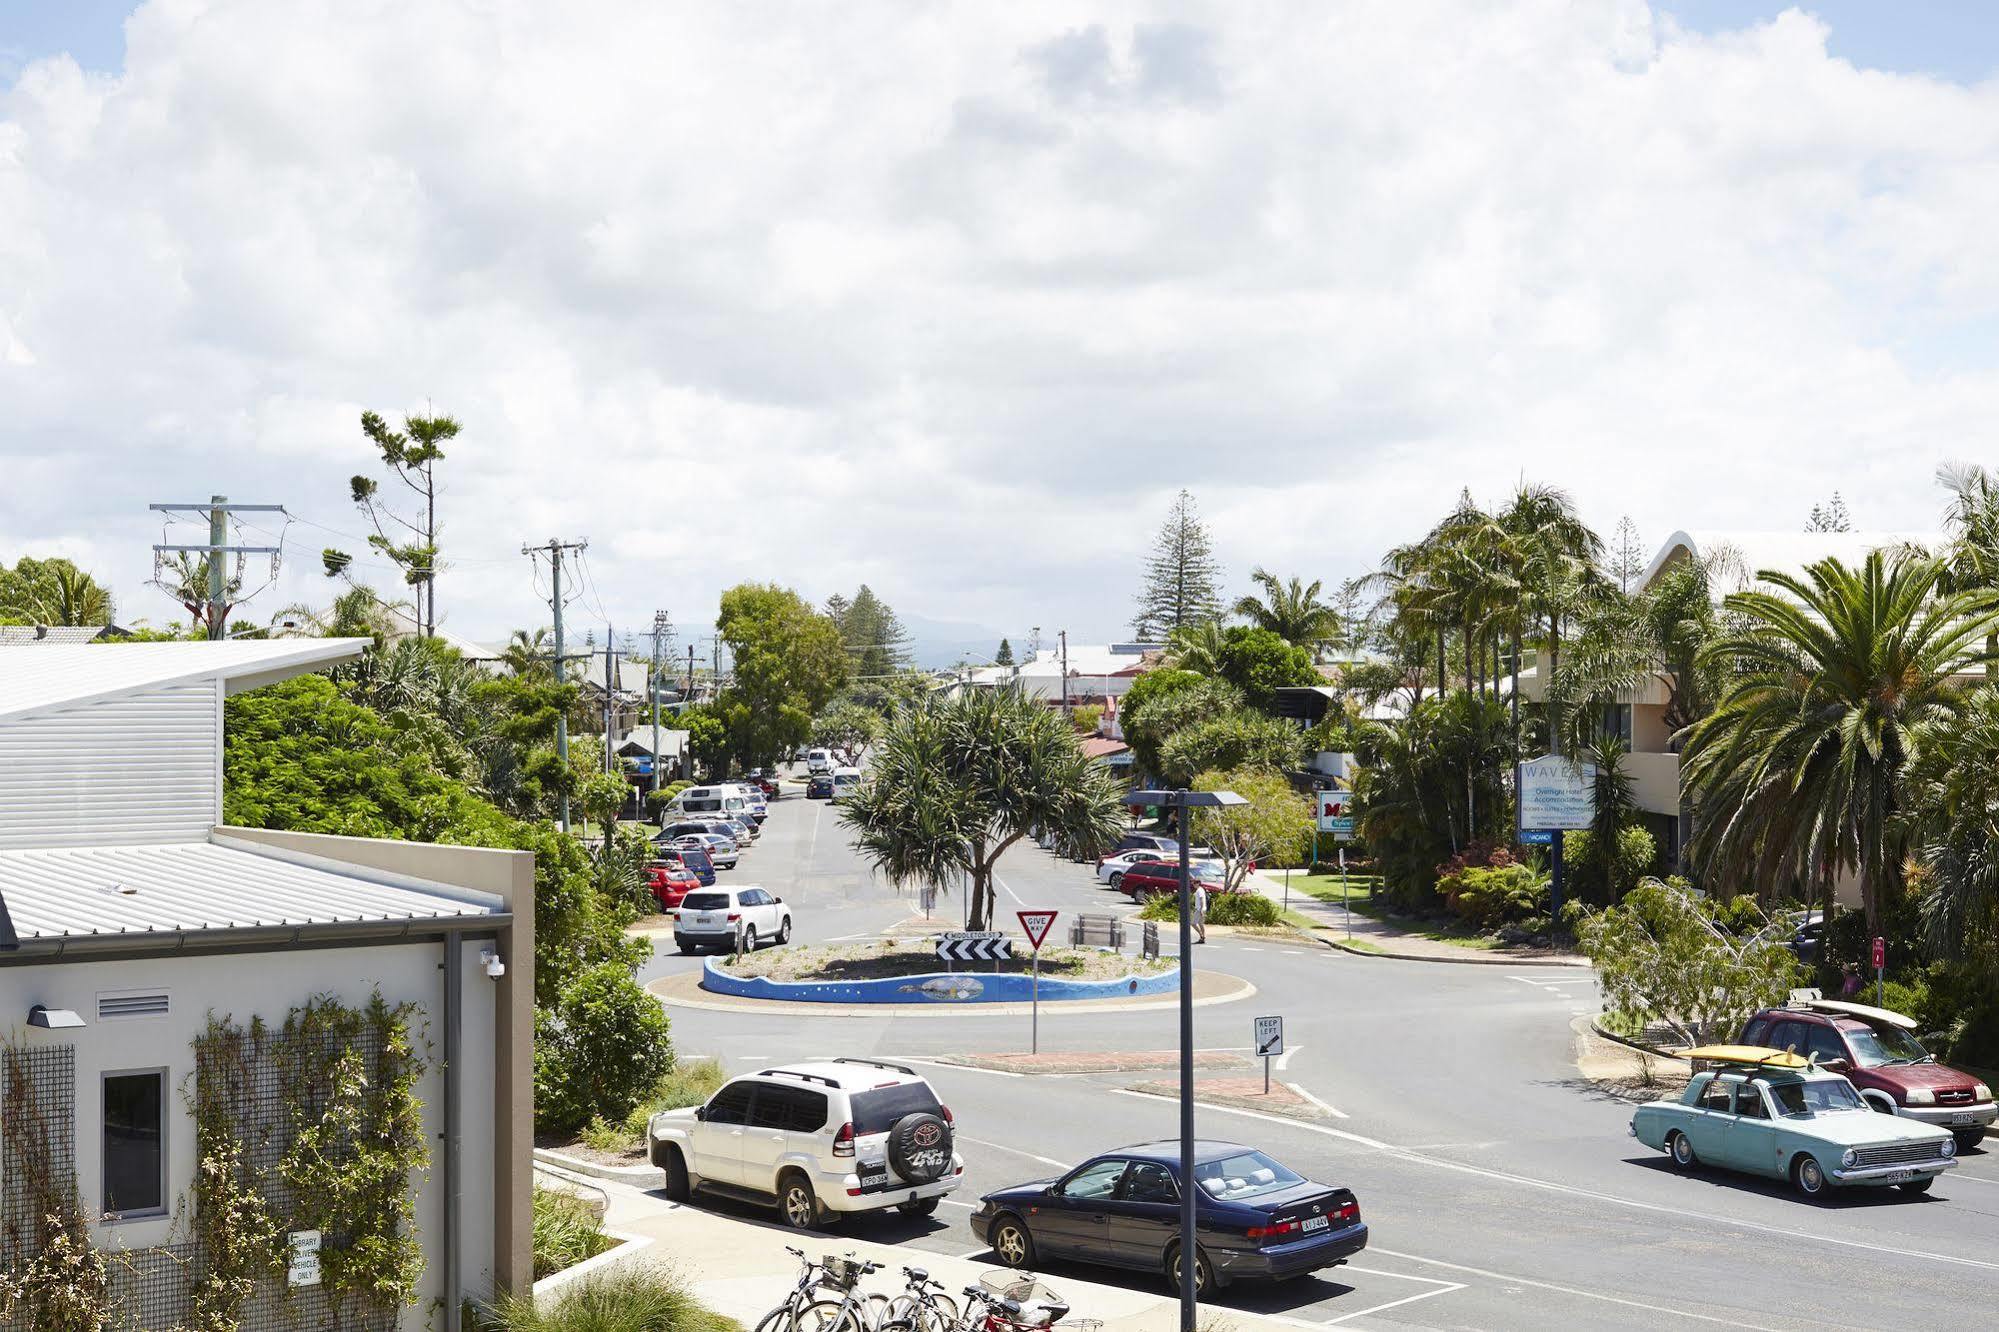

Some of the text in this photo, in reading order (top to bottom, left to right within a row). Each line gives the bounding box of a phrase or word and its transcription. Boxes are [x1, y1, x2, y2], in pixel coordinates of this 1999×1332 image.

[1525, 766, 1581, 778] WAVE
[1535, 788, 1564, 796] Overnight
[1027, 917, 1046, 925] GIVE
[1259, 1019, 1278, 1027] KEEP
[1260, 1027, 1277, 1035] LEFT
[297, 1271, 312, 1280] ONLY
